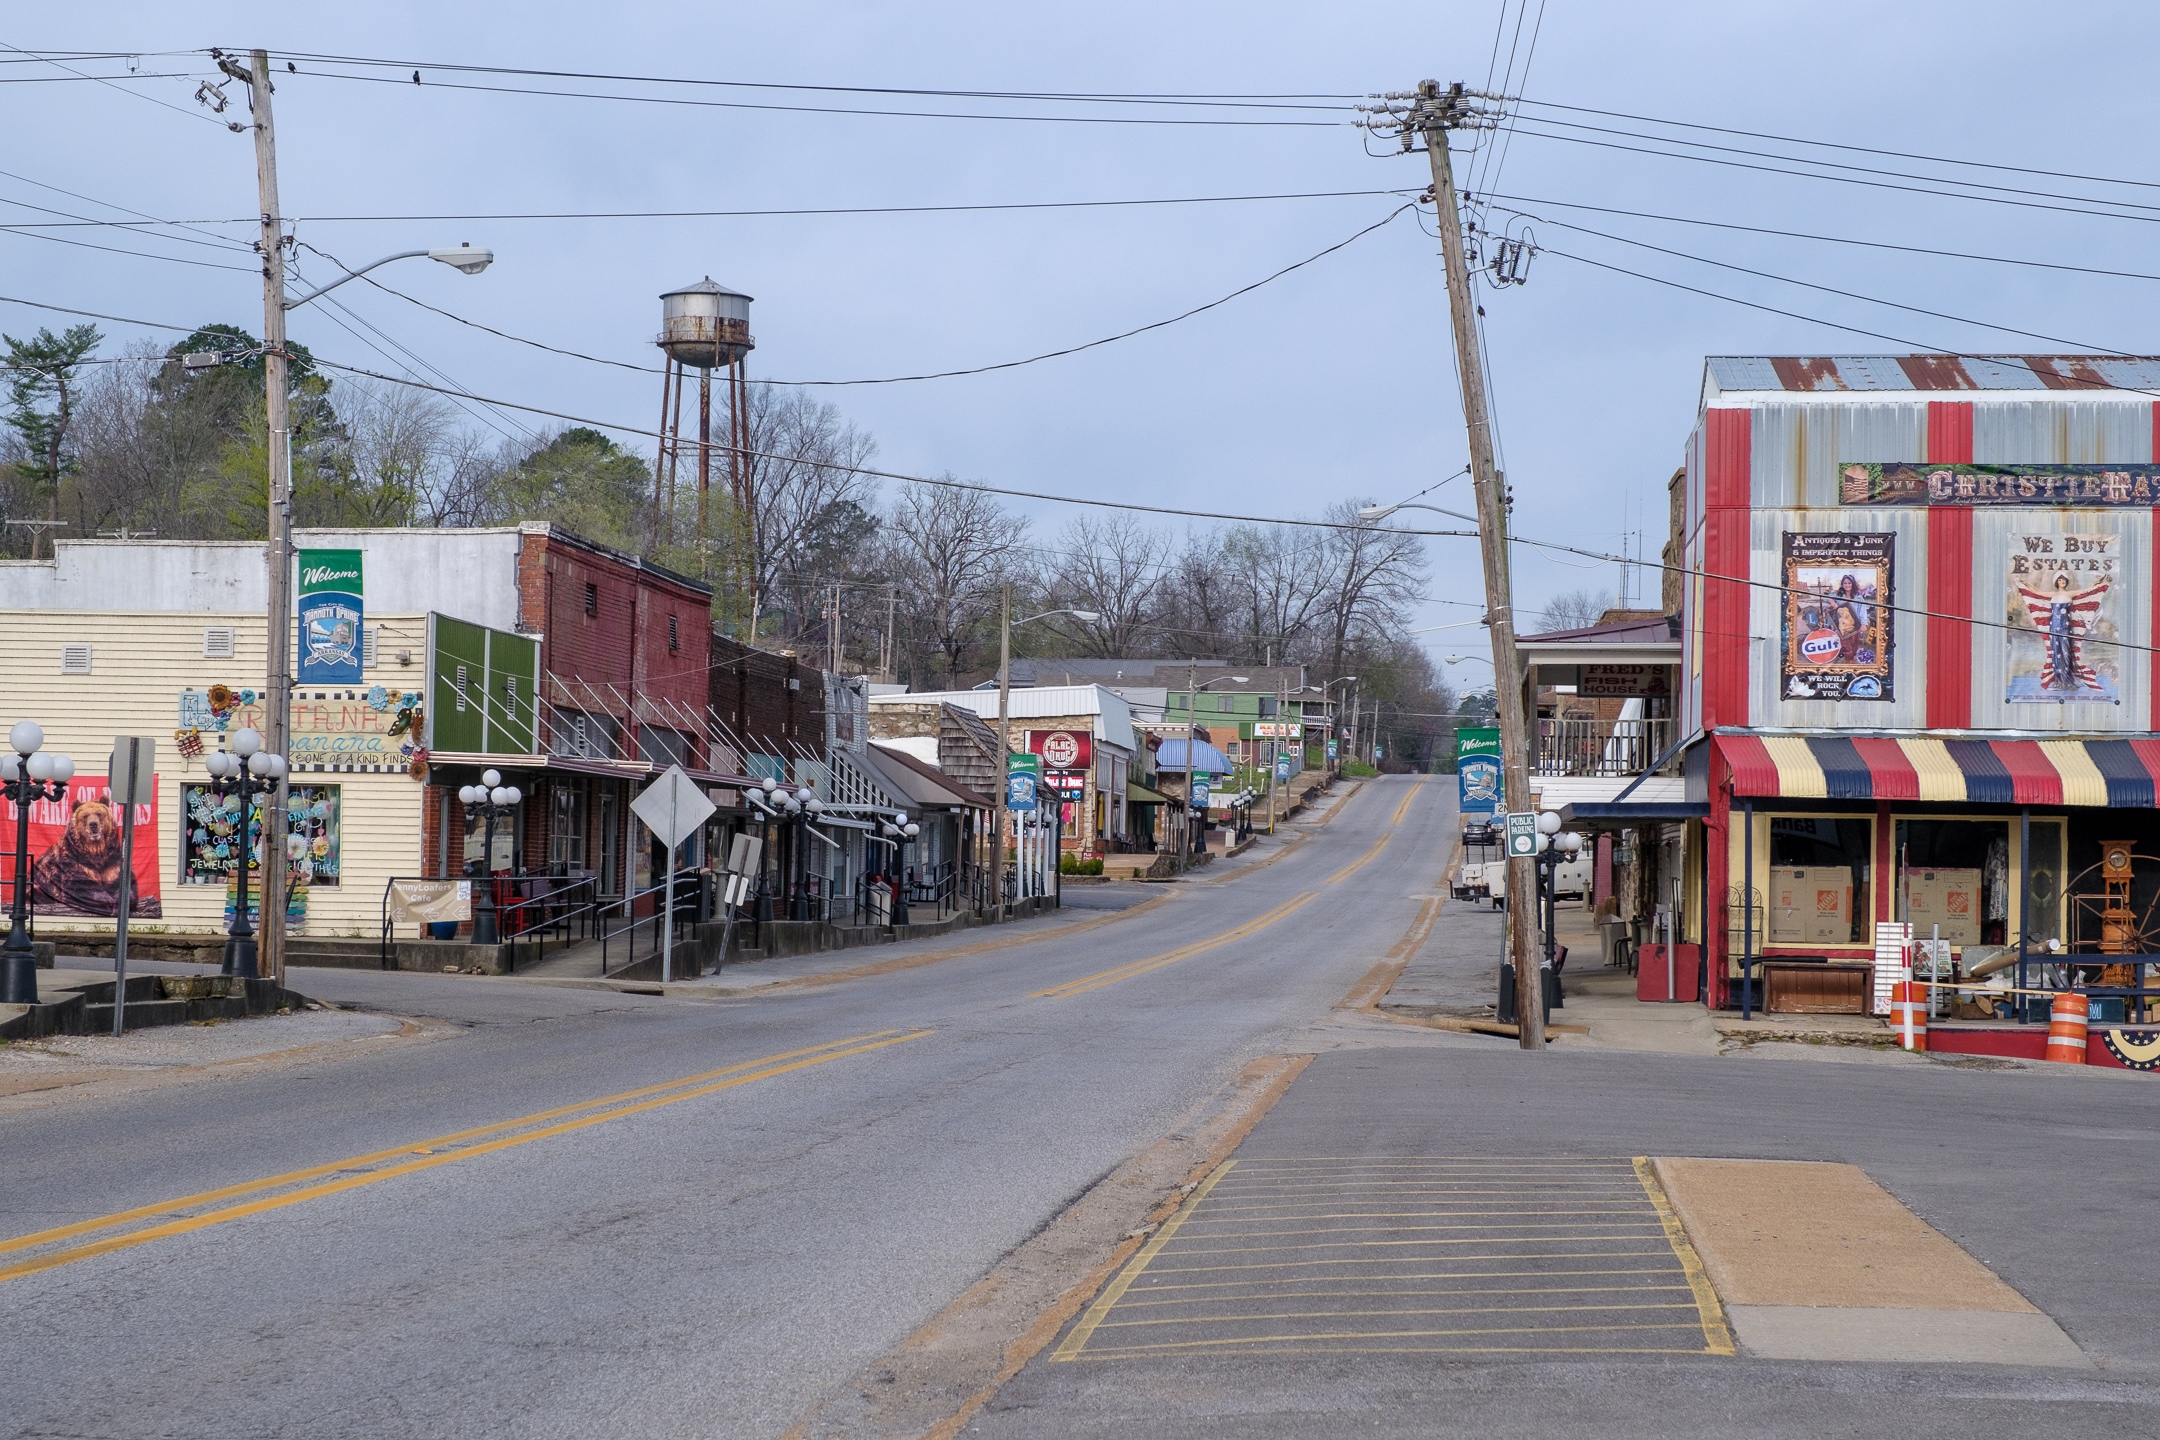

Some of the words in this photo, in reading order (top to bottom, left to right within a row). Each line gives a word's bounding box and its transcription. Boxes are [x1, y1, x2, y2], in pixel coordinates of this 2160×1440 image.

[1792, 535, 1840, 547] ANTIQUES
[1854, 535, 1883, 547] JUNK
[2022, 536, 2054, 553] WE
[2064, 536, 2109, 553] BUY
[2011, 555, 2113, 574] ESTATES
[303, 565, 359, 587] Welcome
[1804, 638, 1840, 653] Gulf
[1587, 664, 1664, 675] FRED'S
[1584, 677, 1637, 685] FISH
[238, 704, 385, 733] RTANA
[1045, 740, 1076, 751] PALACE
[1461, 739, 1497, 752] Welcome
[305, 752, 326, 763] ONE
[330, 752, 342, 763] OF
[347, 752, 354, 763] A
[357, 752, 381, 763] KIND
[384, 752, 412, 763] FINDS
[1049, 750, 1071, 761] DRUG
[1511, 816, 1534, 827] PUBLIC
[1511, 826, 1535, 835] PARKING
[190, 858, 234, 872] JEWELRY
[392, 882, 452, 893] PennyLoafers
[410, 894, 432, 902] Cafe
